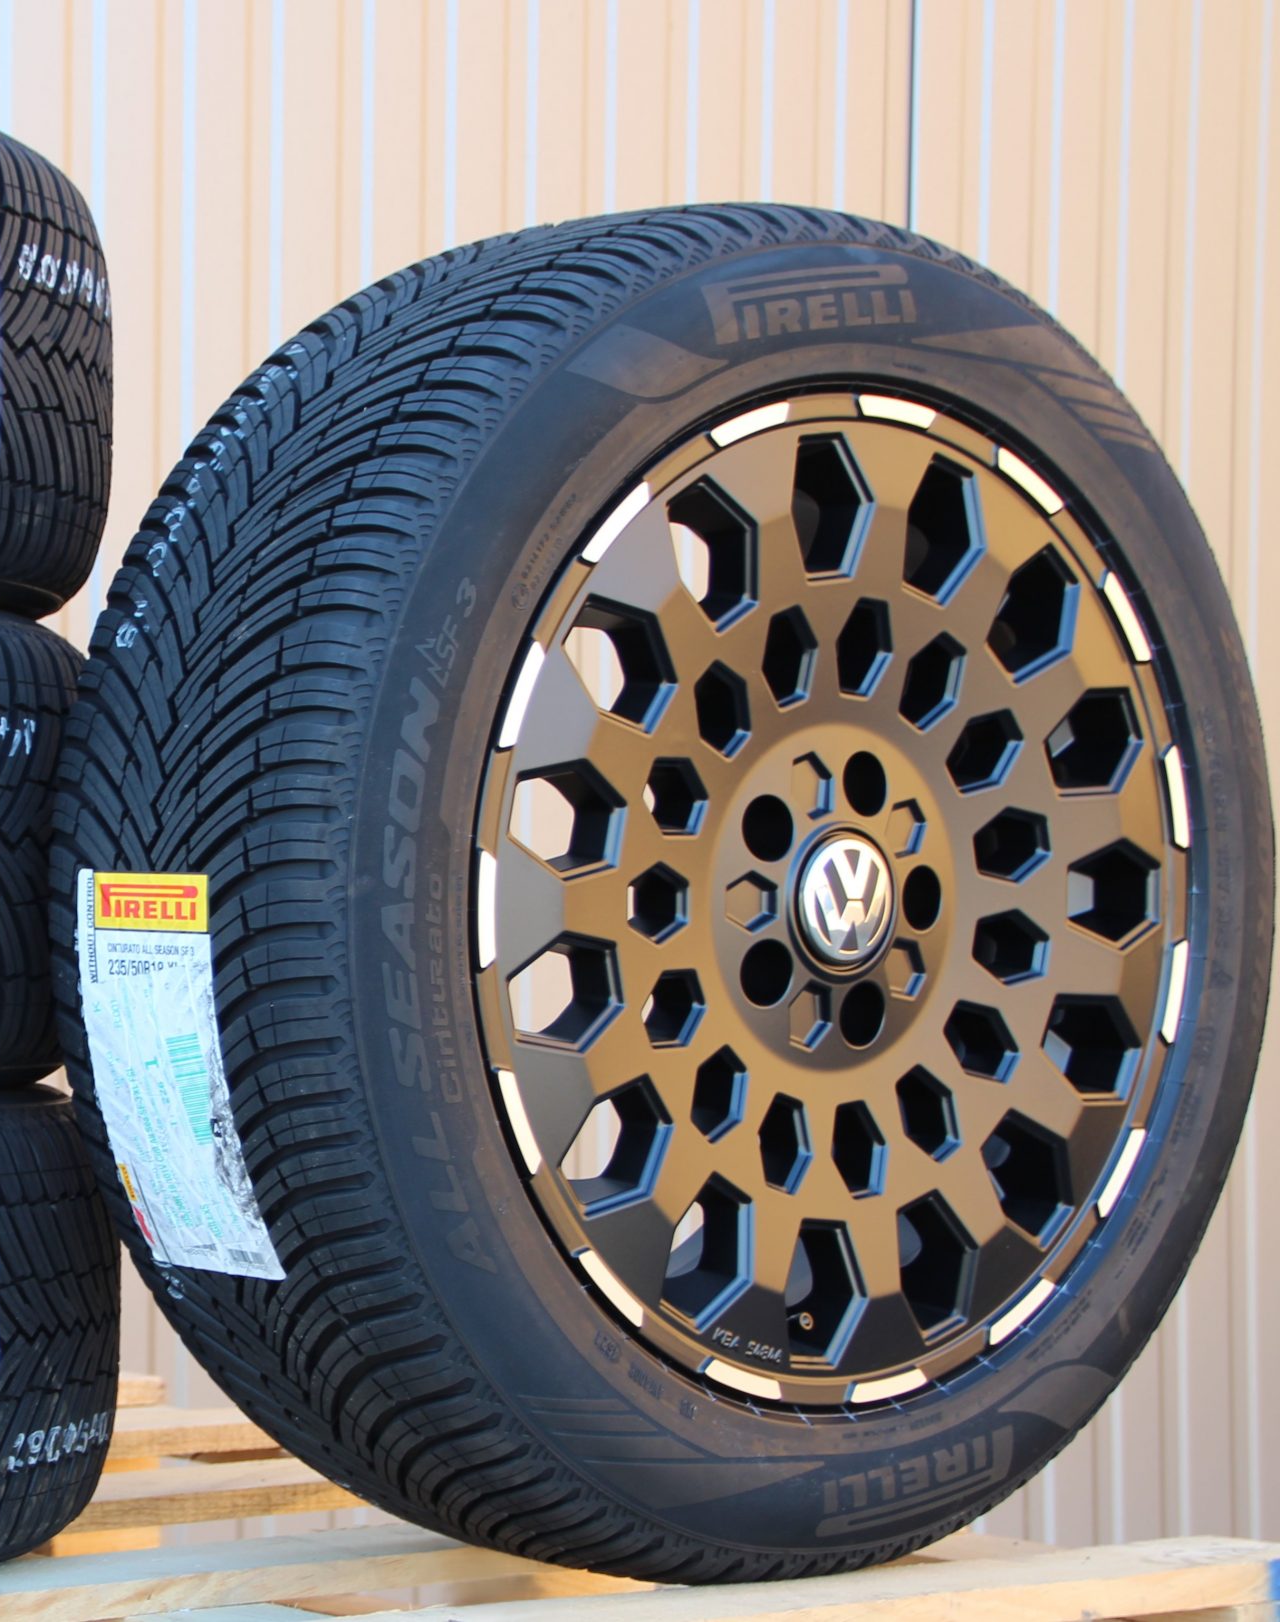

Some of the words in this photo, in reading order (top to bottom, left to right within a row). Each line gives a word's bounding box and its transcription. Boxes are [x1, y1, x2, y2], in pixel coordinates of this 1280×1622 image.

[701, 264, 917, 345] PIRELLI
[86, 877, 95, 928] CONTROL
[100, 883, 198, 921] PIRELLI
[381, 676, 440, 1091] SEASON
[86, 933, 98, 984] WITHOUT
[107, 942, 140, 955] CINTURATO
[142, 943, 153, 955] ALL
[154, 944, 180, 956] SEASON
[411, 1111, 498, 1274] ALL
[815, 1425, 1014, 1537] PIRELLI
